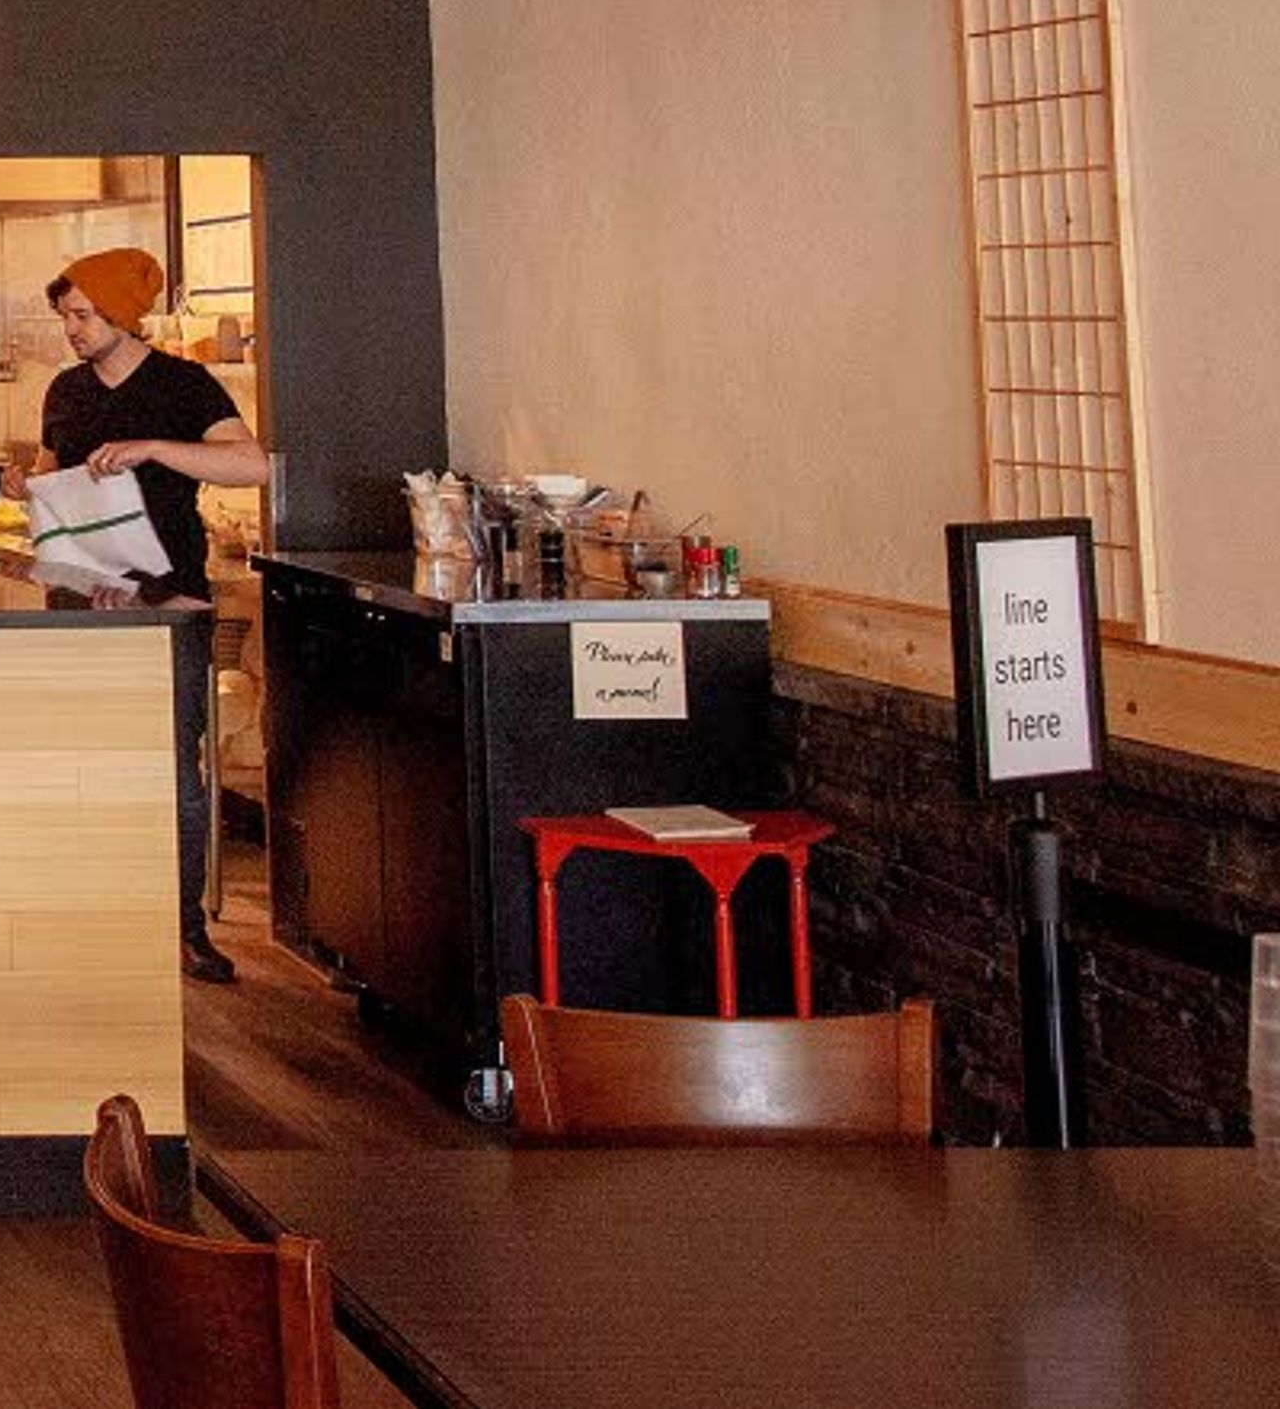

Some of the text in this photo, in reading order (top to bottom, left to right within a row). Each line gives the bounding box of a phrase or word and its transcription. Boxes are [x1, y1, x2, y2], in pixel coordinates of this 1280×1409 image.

[1003, 592, 1049, 625] line
[994, 651, 1067, 685] starts
[1006, 709, 1061, 743] here
